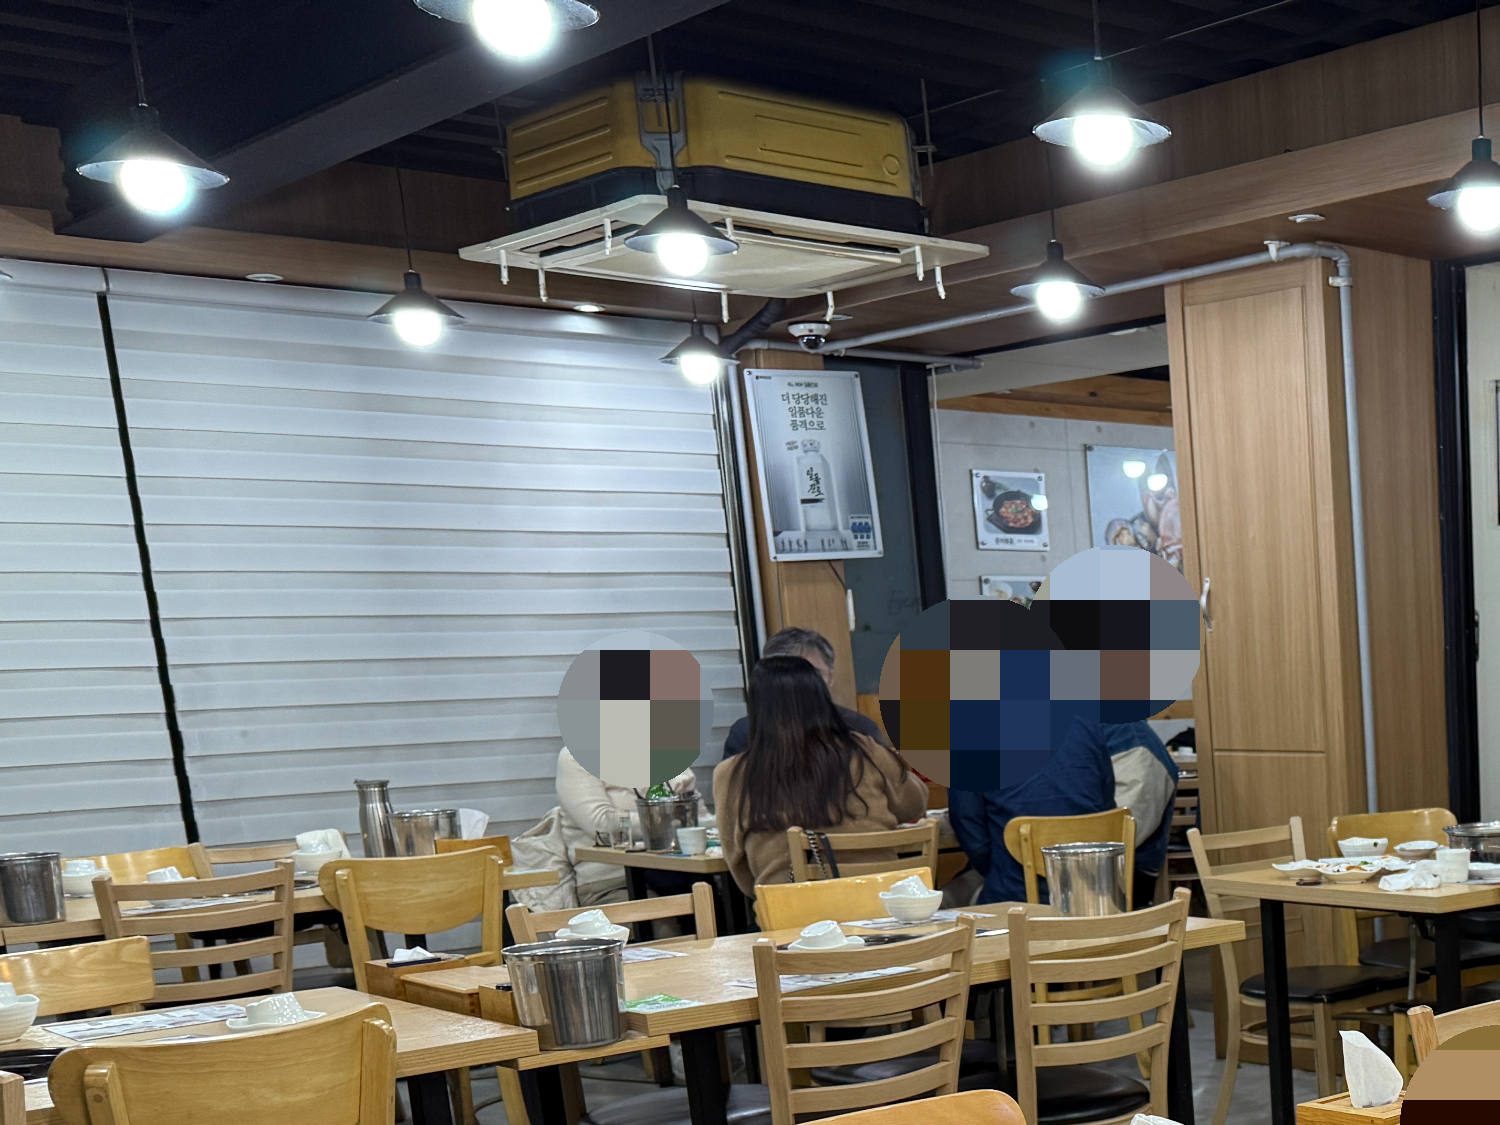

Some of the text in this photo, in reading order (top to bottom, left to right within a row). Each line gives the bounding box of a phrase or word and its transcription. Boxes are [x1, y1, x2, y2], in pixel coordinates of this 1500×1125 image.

[781, 392, 790, 404] 더
[788, 406, 824, 418] 일품다운
[790, 420, 826, 431] 품격으로
